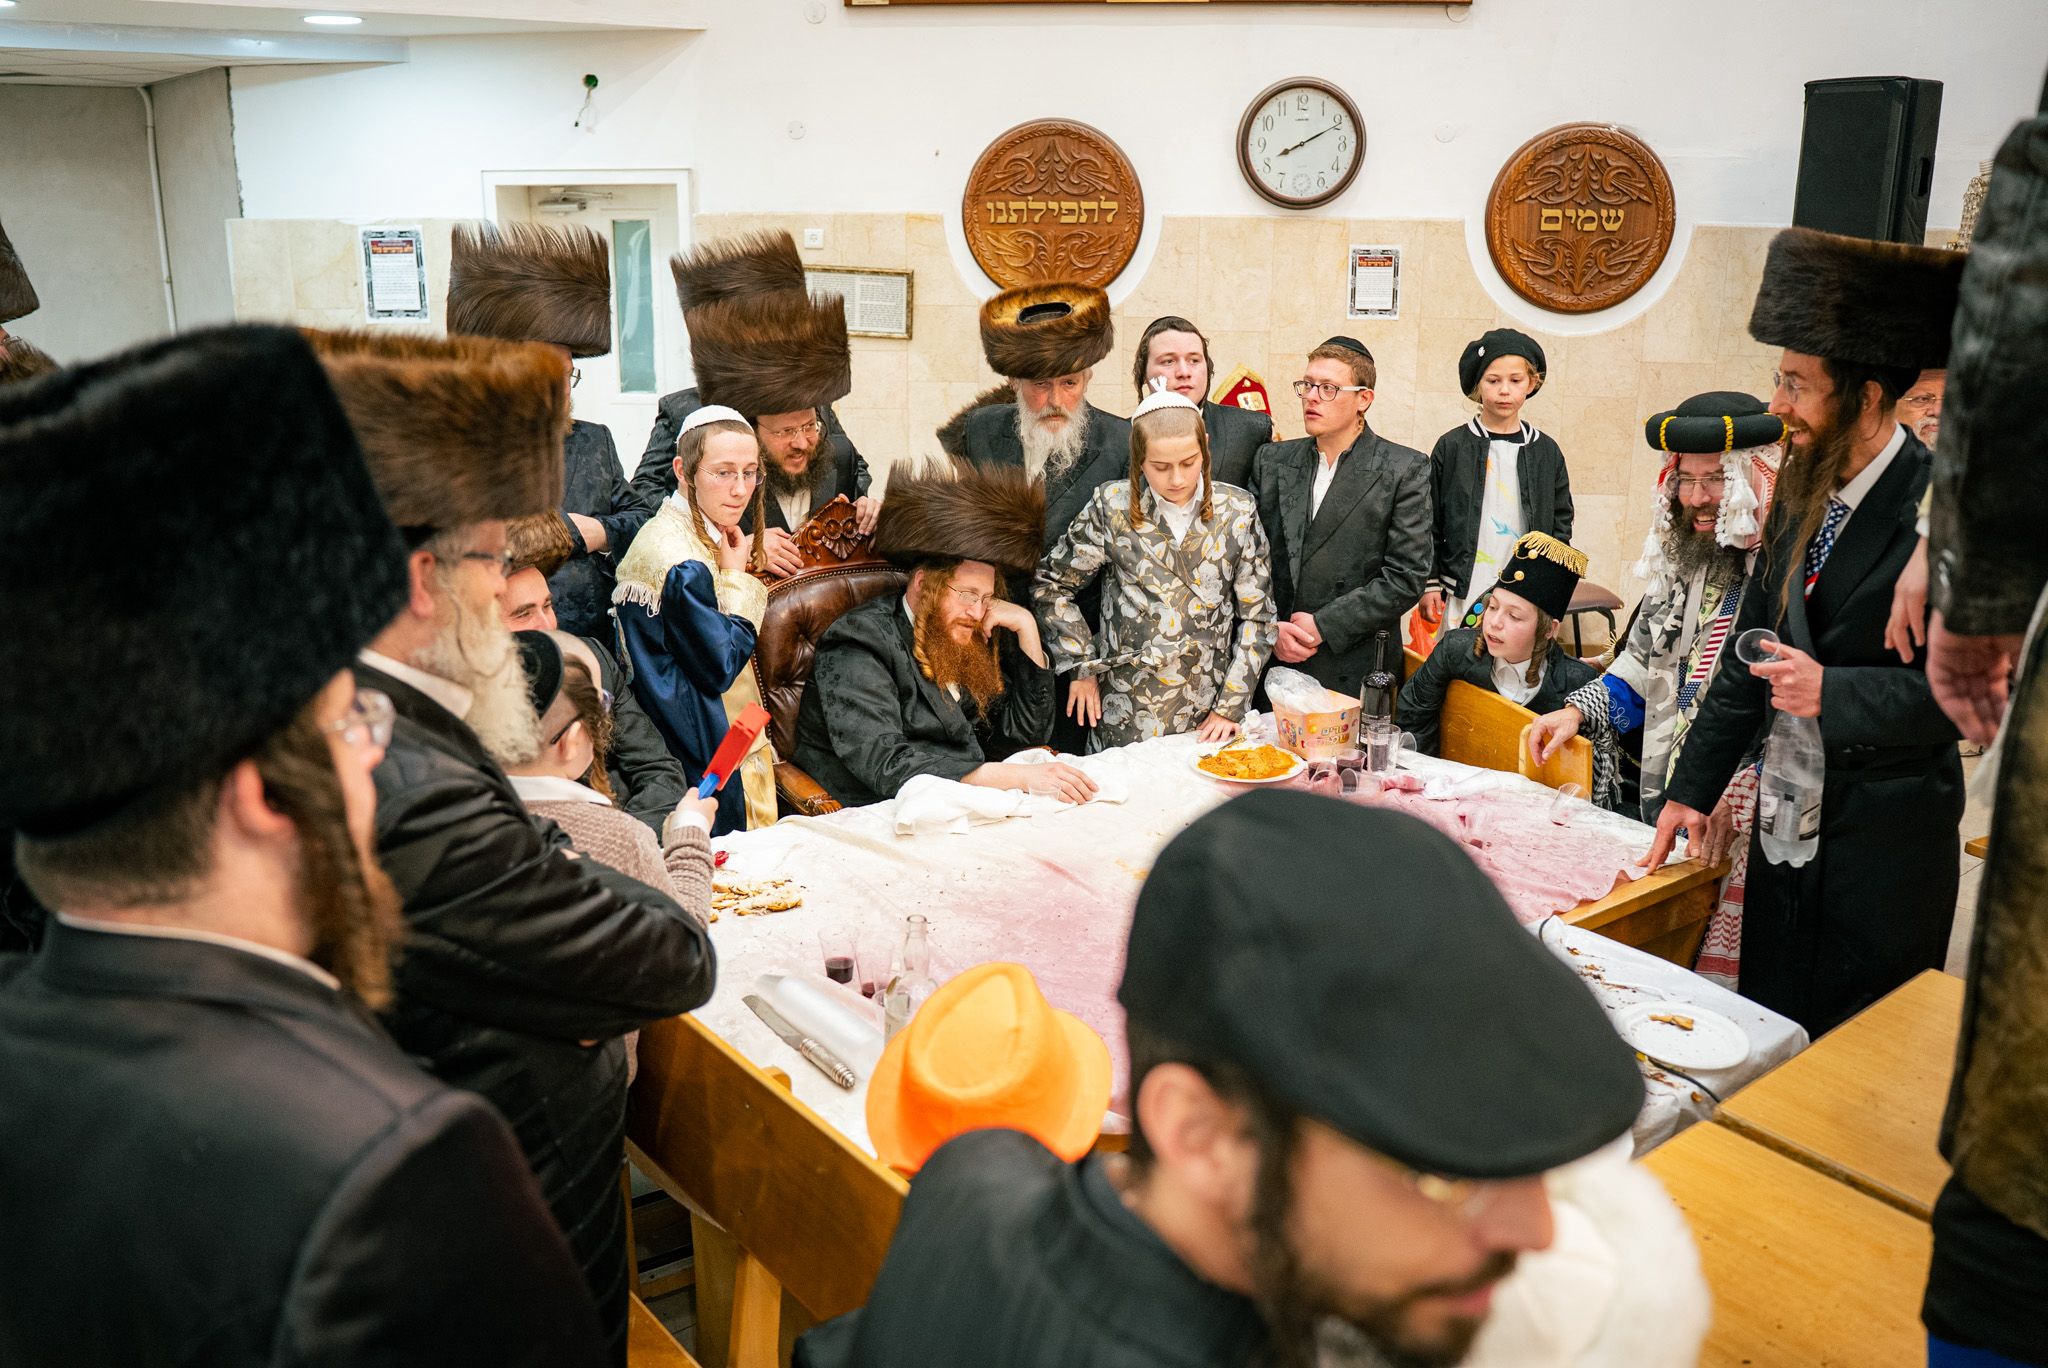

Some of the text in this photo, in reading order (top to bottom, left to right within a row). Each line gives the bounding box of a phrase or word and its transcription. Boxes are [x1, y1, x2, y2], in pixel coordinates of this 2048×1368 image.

[1278, 100, 1287, 117] 11
[1297, 94, 1309, 111] 12
[1262, 115, 1274, 132] 10
[1333, 114, 1342, 131] 2
[1257, 136, 1267, 153] 9
[1337, 135, 1347, 152] 3
[1262, 157, 1272, 174] 8
[1331, 156, 1340, 173] 4
[1278, 172, 1286, 189] 7
[1316, 171, 1326, 188] 5
[986, 195, 1118, 224] לתפילתנו
[1540, 207, 1625, 232] שמים
